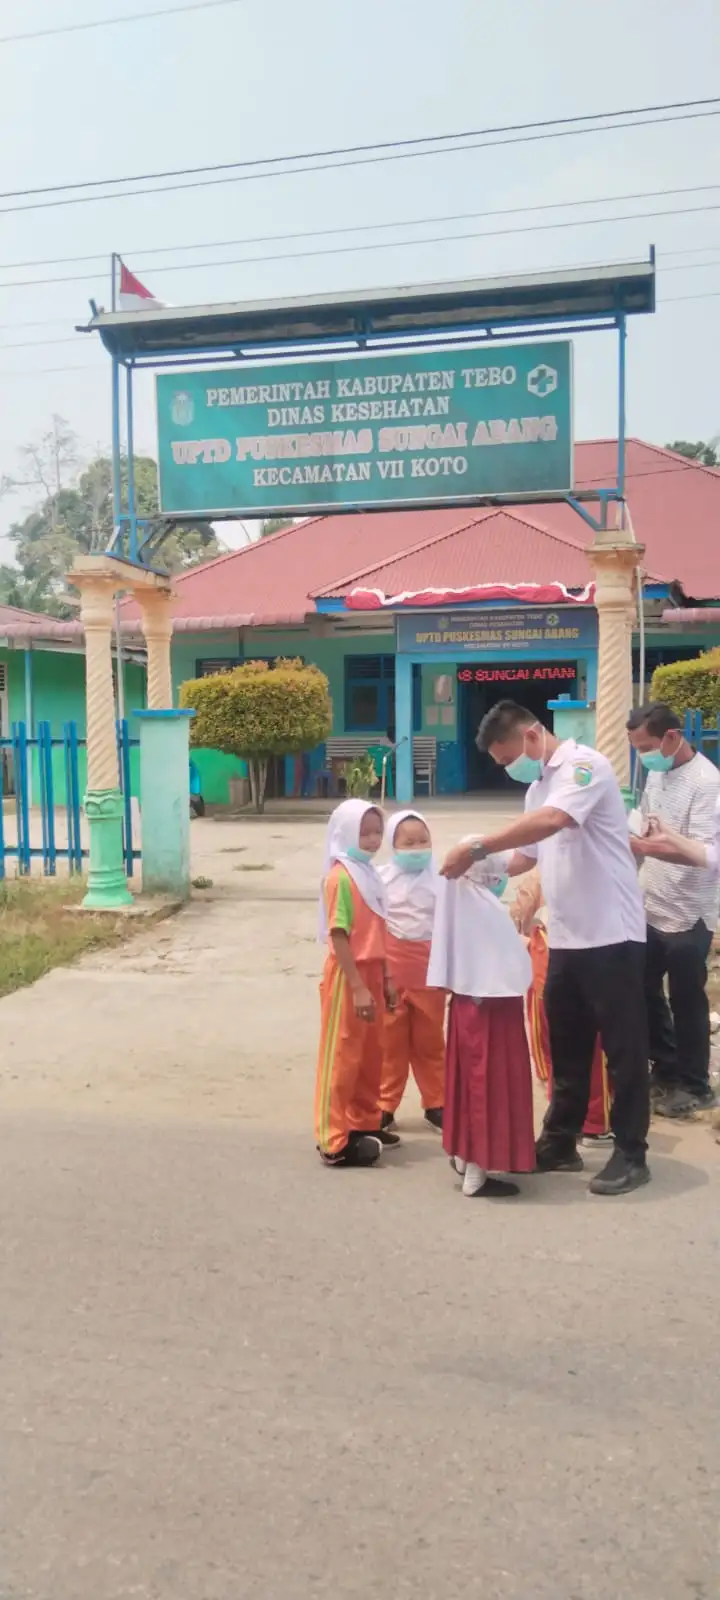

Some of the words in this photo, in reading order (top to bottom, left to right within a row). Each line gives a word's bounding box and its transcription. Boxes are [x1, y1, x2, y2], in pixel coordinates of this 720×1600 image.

[207, 379, 331, 407] PEMERINTAH
[336, 370, 455, 398] KABUPATEN
[461, 365, 517, 389] TEBO
[267, 406, 325, 427] DINAS
[331, 396, 450, 423] KESEHATAN
[171, 438, 232, 465] UPTD
[236, 428, 374, 461] PUSKESMAS
[378, 422, 469, 453] SUNGAI
[472, 415, 558, 446] ABANG
[252, 462, 372, 487] KECAMATAN
[376, 460, 404, 479] VII
[411, 455, 468, 477] KOTO
